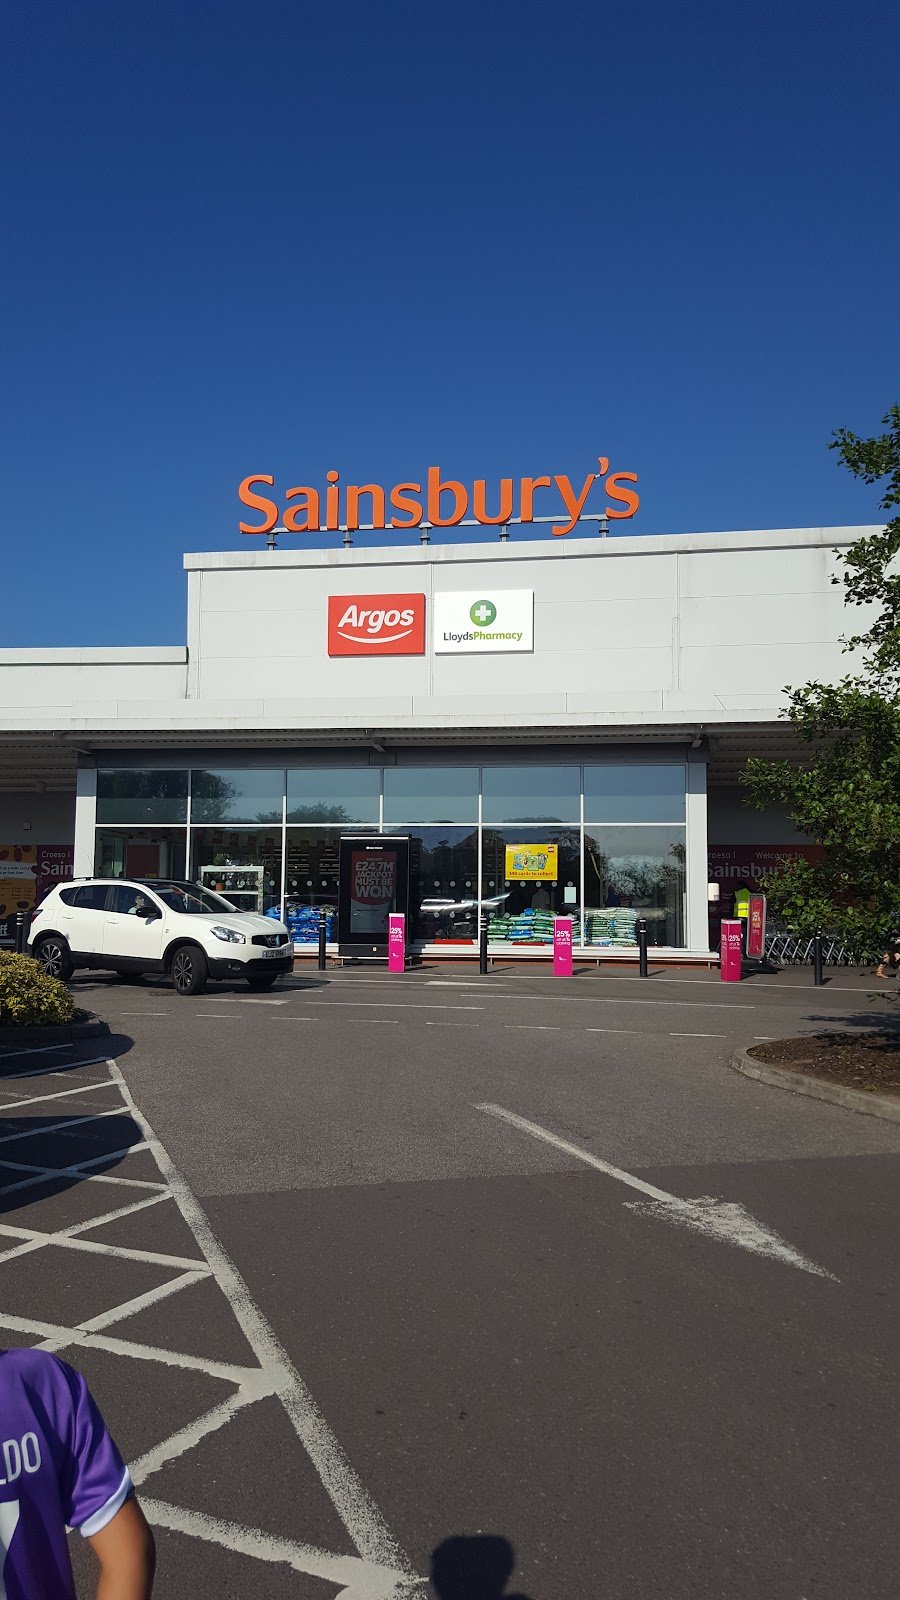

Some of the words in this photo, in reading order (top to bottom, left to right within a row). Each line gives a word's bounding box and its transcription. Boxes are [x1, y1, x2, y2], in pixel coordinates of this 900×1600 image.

[238, 456, 640, 536] Sainsbury's
[338, 604, 415, 634] Argos
[443, 630, 523, 643] LloydsPharmacy
[755, 851, 793, 859] Welcome
[355, 878, 381, 886] MUST
[381, 878, 393, 886] BE
[355, 885, 393, 898] WON
[0, 1431, 42, 1485] DO
